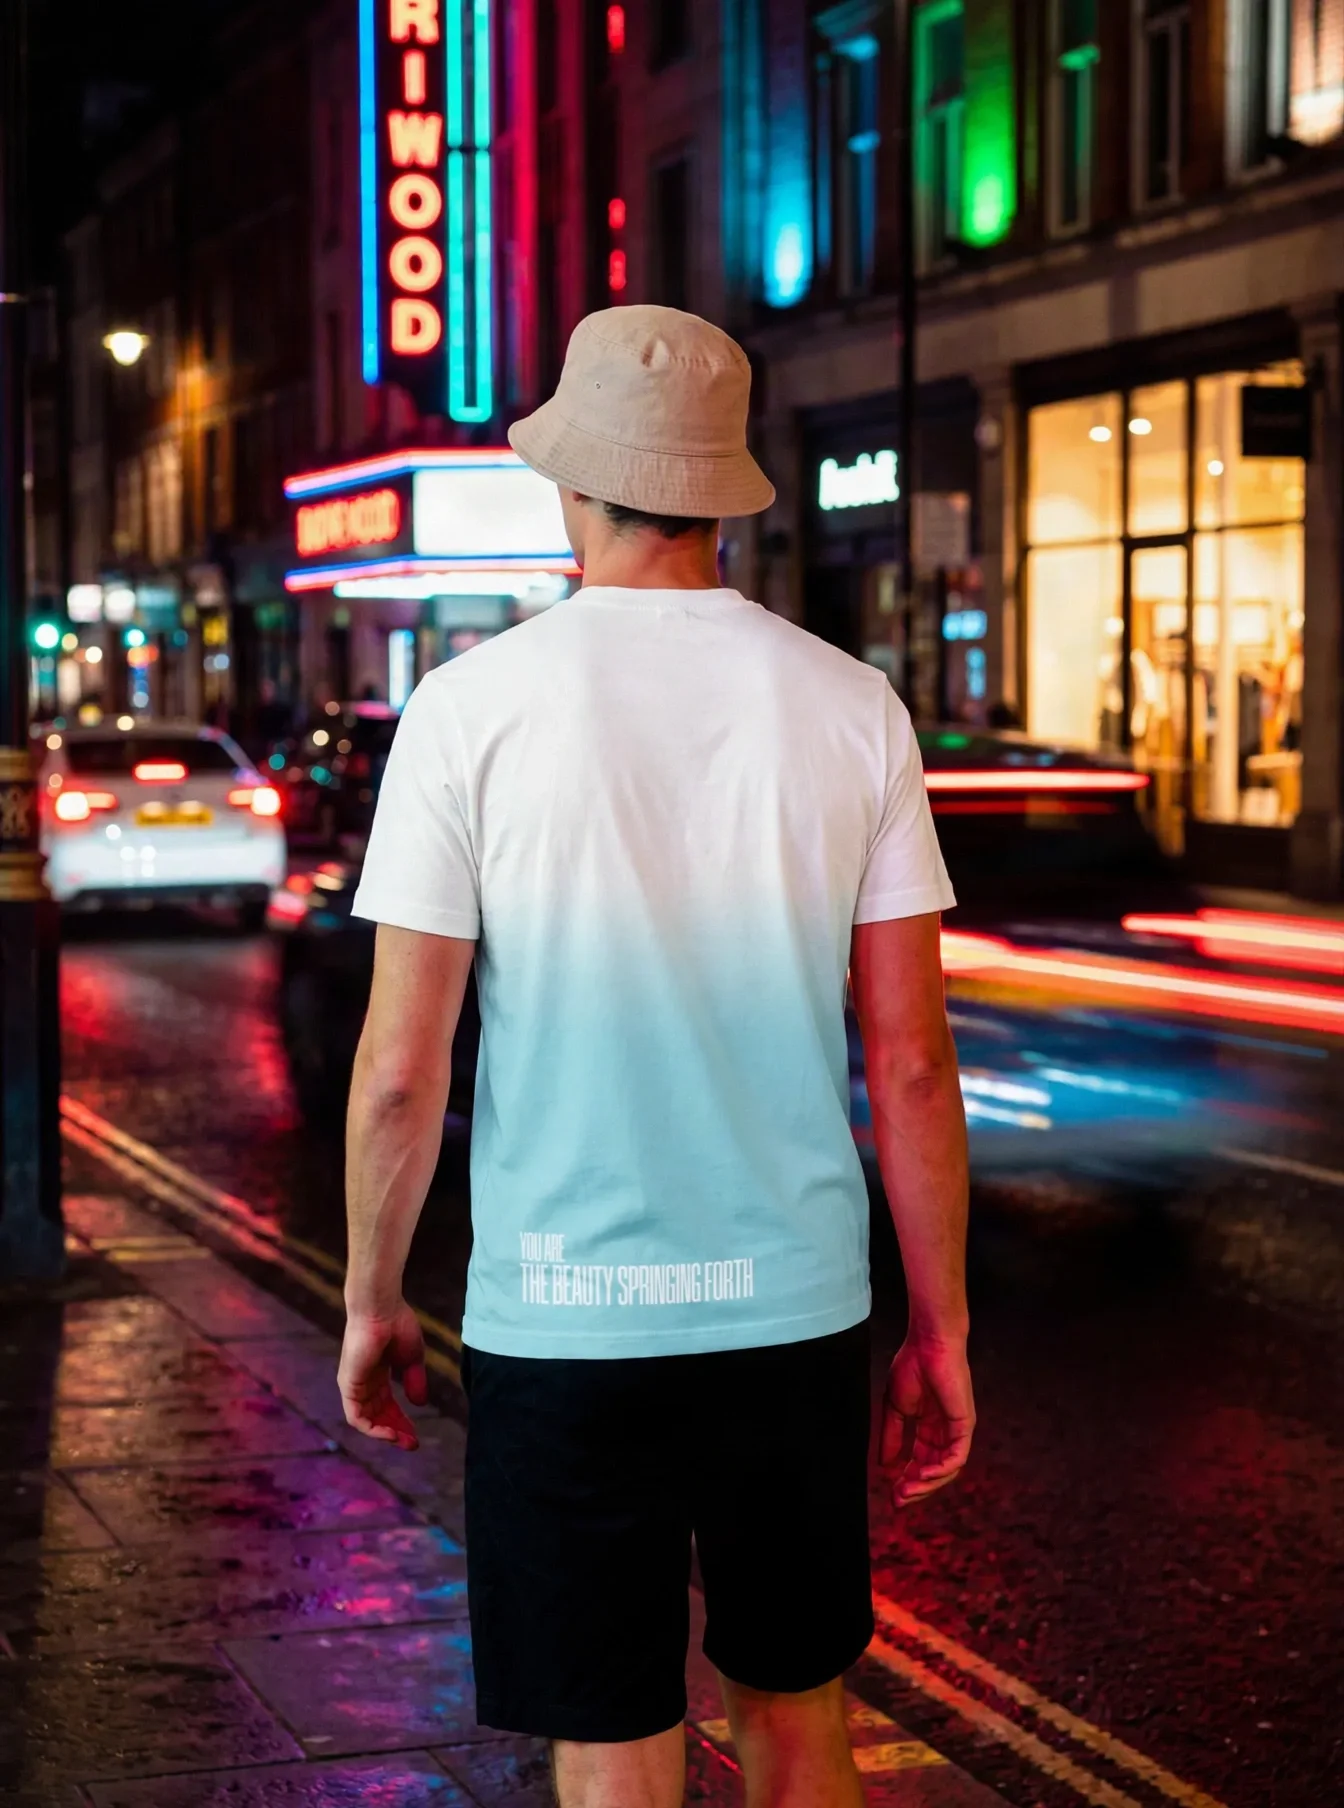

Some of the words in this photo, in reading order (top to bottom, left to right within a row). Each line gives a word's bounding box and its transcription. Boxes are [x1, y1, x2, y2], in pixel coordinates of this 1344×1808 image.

[388, 0, 443, 355] RIWOOD
[519, 1231, 542, 1261] YOU
[544, 1233, 565, 1262] ARE
[519, 1263, 549, 1305] THE
[552, 1264, 614, 1306] BEAUTY
[617, 1262, 701, 1306] SPRINGING
[704, 1258, 753, 1301] FORTH
